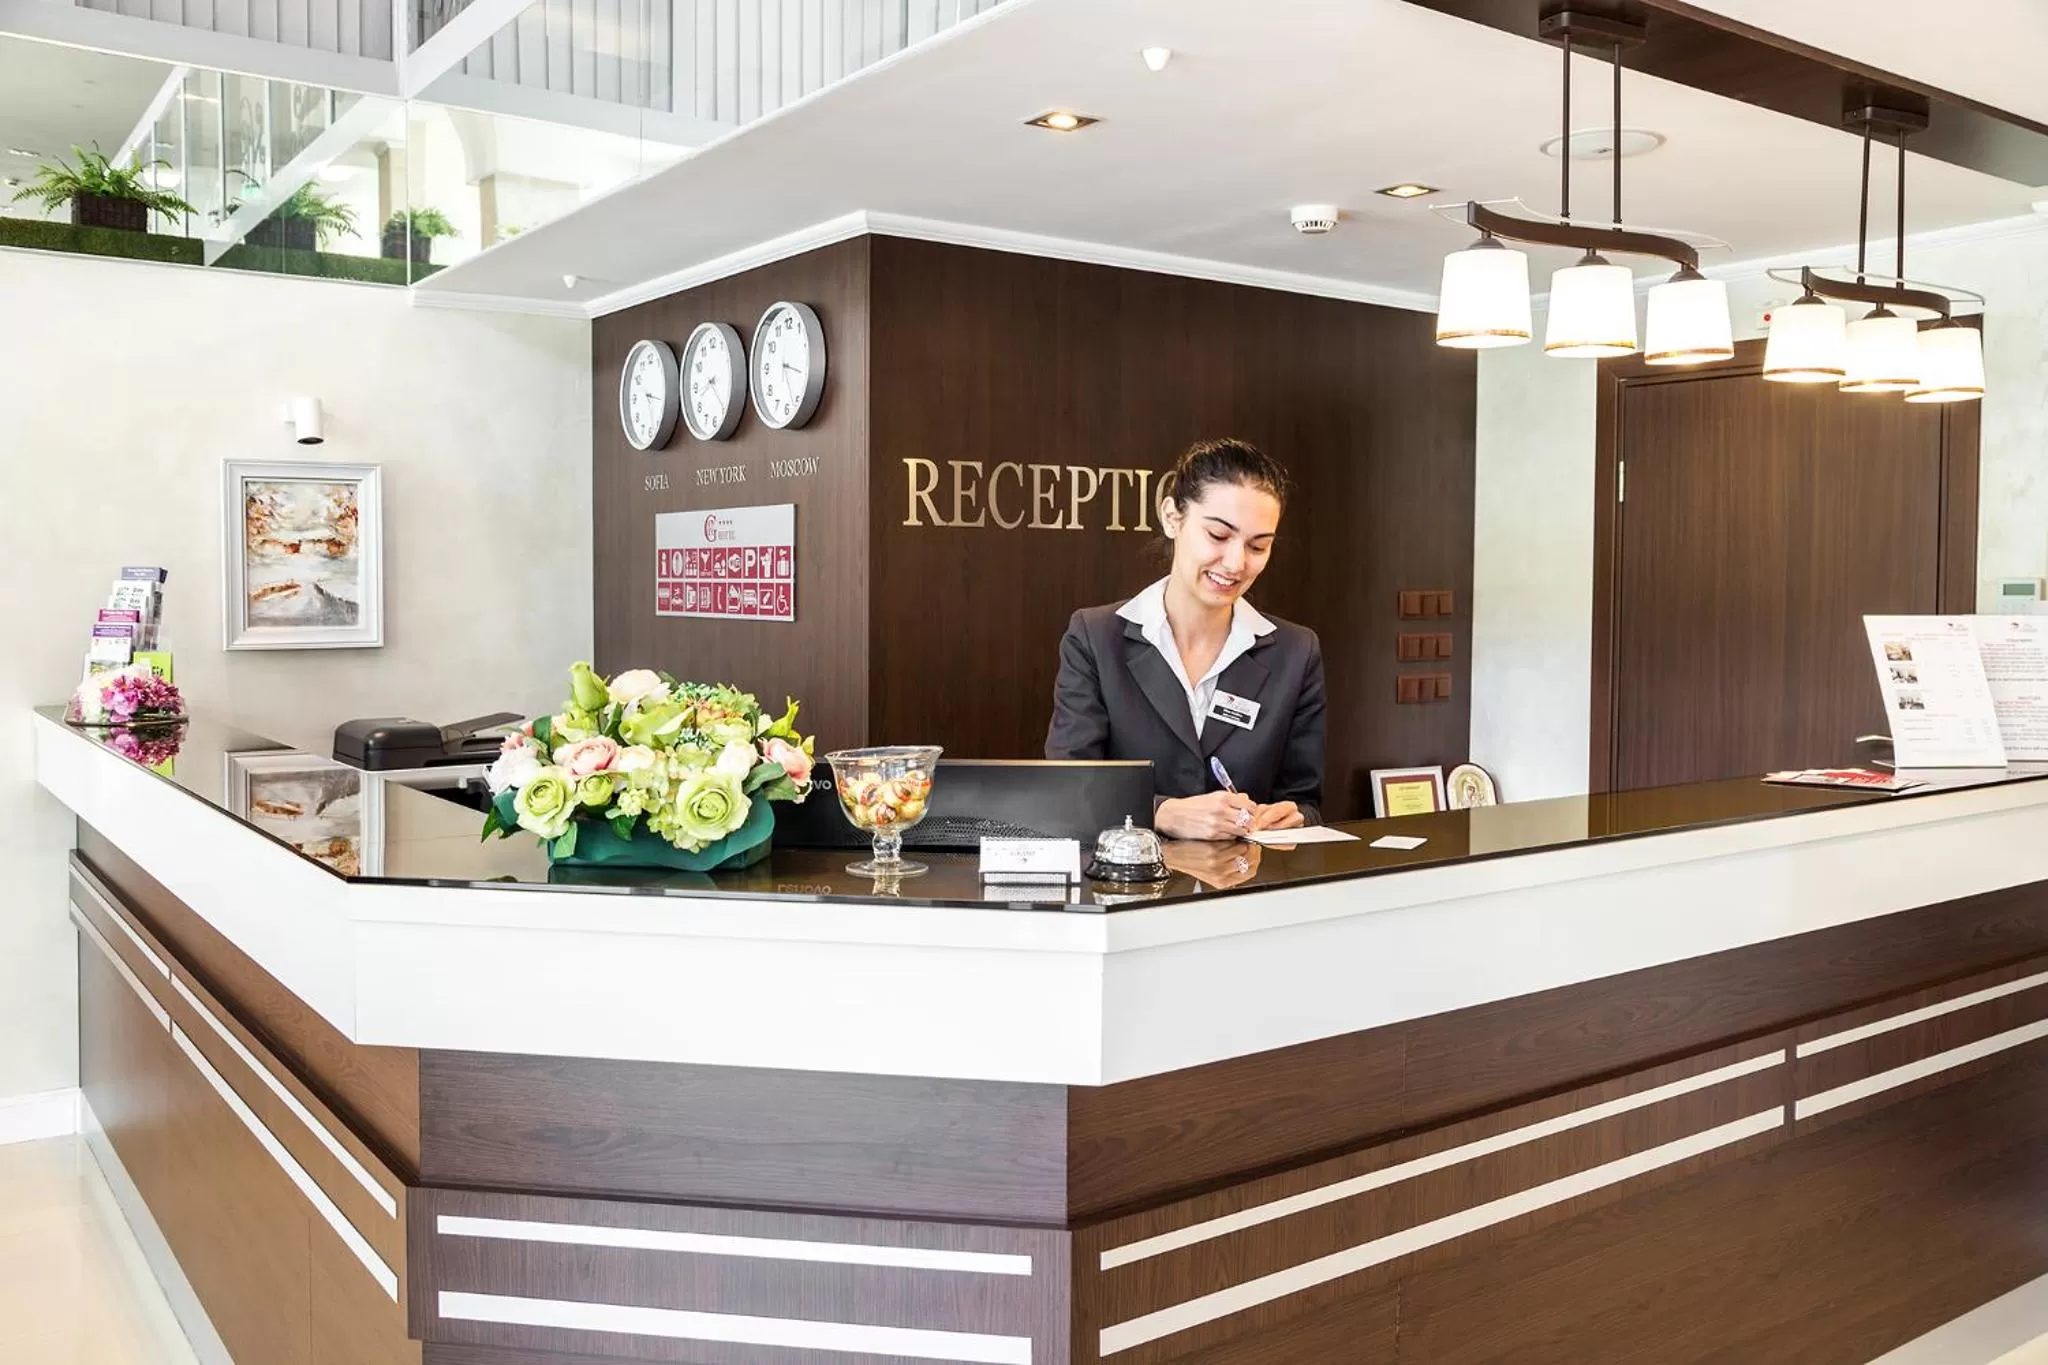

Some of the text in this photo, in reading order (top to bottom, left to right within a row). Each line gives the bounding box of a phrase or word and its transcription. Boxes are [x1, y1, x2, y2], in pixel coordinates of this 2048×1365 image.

[696, 464, 747, 486] NEW YORK
[770, 456, 820, 479] MOSCOW
[644, 473, 670, 491] SOFIA
